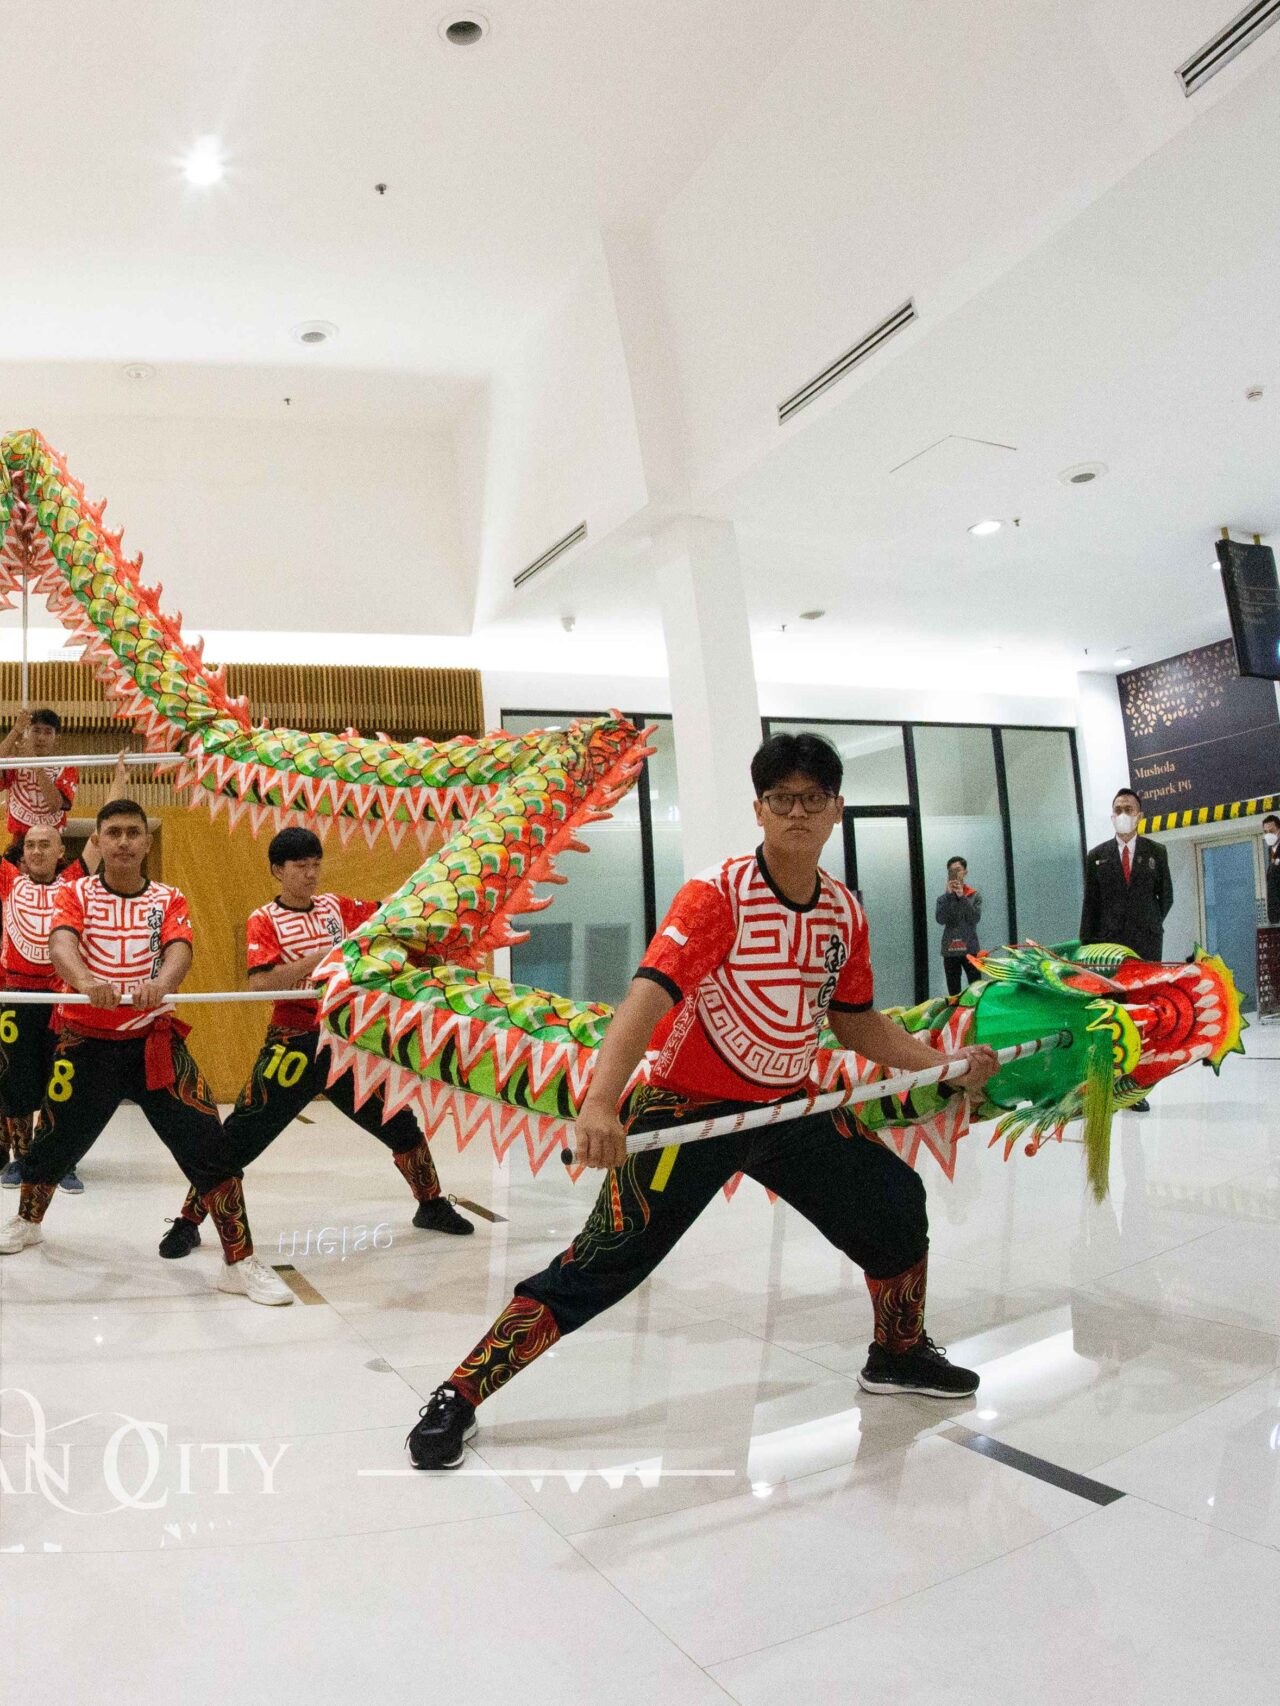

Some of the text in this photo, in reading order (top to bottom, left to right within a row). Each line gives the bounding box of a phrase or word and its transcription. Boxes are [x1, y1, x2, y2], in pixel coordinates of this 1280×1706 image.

[1135, 761, 1175, 779] Mushola
[1136, 782, 1177, 800] Carpark
[0, 1009, 19, 1044] 6
[48, 1059, 75, 1102] 8
[263, 1044, 308, 1088] 10
